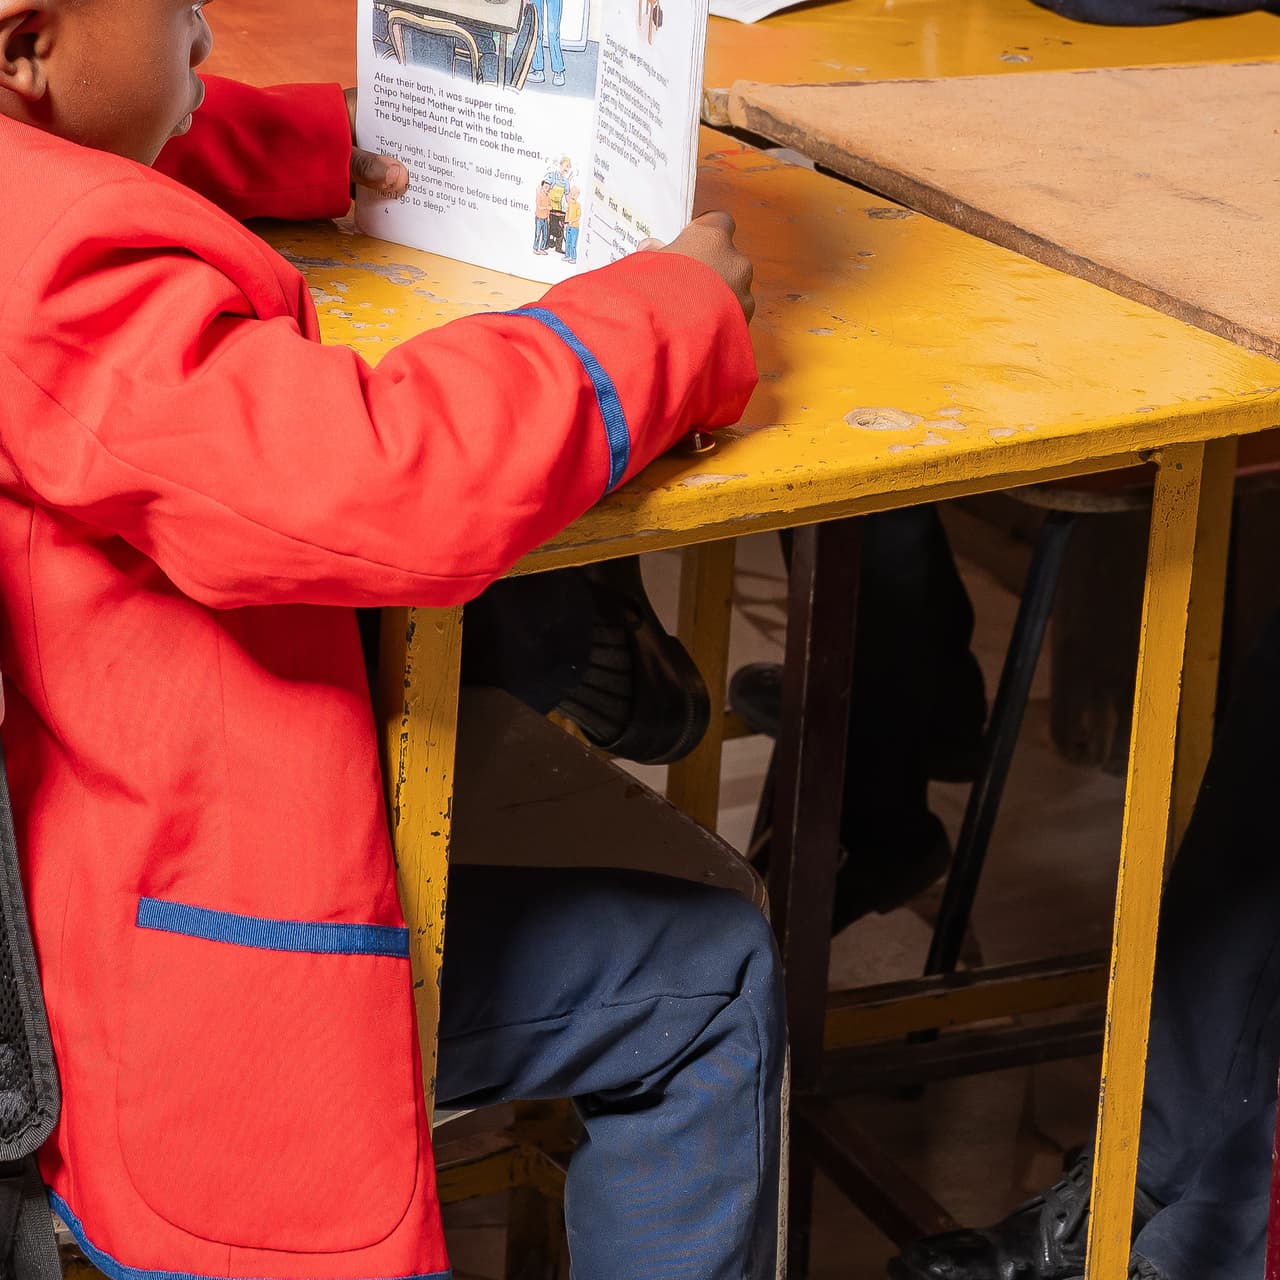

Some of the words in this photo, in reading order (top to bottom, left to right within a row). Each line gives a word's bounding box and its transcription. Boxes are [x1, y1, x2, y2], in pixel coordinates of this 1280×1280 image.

[374, 72, 394, 84] After
[396, 76, 414, 89] their
[417, 82, 436, 96] bath,
[438, 88, 445, 97] it
[446, 92, 463, 102] was
[465, 96, 492, 110] supper
[495, 102, 517, 115] time.
[374, 85, 398, 99] Chipo
[400, 90, 425, 106] helped
[427, 98, 456, 113] Mother
[458, 107, 476, 118] with
[478, 111, 490, 122] the
[493, 114, 515, 128] food.
[374, 97, 400, 113] Jenny
[402, 103, 427, 118] helped
[429, 112, 448, 124] Aunt
[450, 117, 463, 128] Pat
[466, 122, 483, 133] with
[485, 127, 498, 138] the
[500, 129, 525, 144] table.
[375, 108, 390, 120] The
[392, 111, 411, 127] boys
[412, 119, 437, 134] helped
[438, 126, 461, 140] Uncle
[463, 133, 478, 145] Tim
[480, 137, 499, 150] cook
[501, 142, 515, 155] the
[517, 147, 543, 160] meat.
[400, 156, 412, 165] we
[413, 159, 427, 169] eat
[428, 163, 456, 178] supper.
[405, 142, 426, 158] night,
[433, 151, 450, 163] bath
[475, 165, 492, 177] said
[494, 168, 524, 185] Jenny.
[400, 194, 411, 204] go
[413, 196, 420, 206] to
[405, 184, 427, 195] reads
[436, 191, 456, 206] story
[458, 196, 467, 206] to
[468, 201, 479, 211] us.
[420, 174, 443, 187] some
[445, 181, 464, 193] more
[466, 185, 491, 201] before
[492, 192, 508, 205] bed
[510, 199, 531, 212] time.
